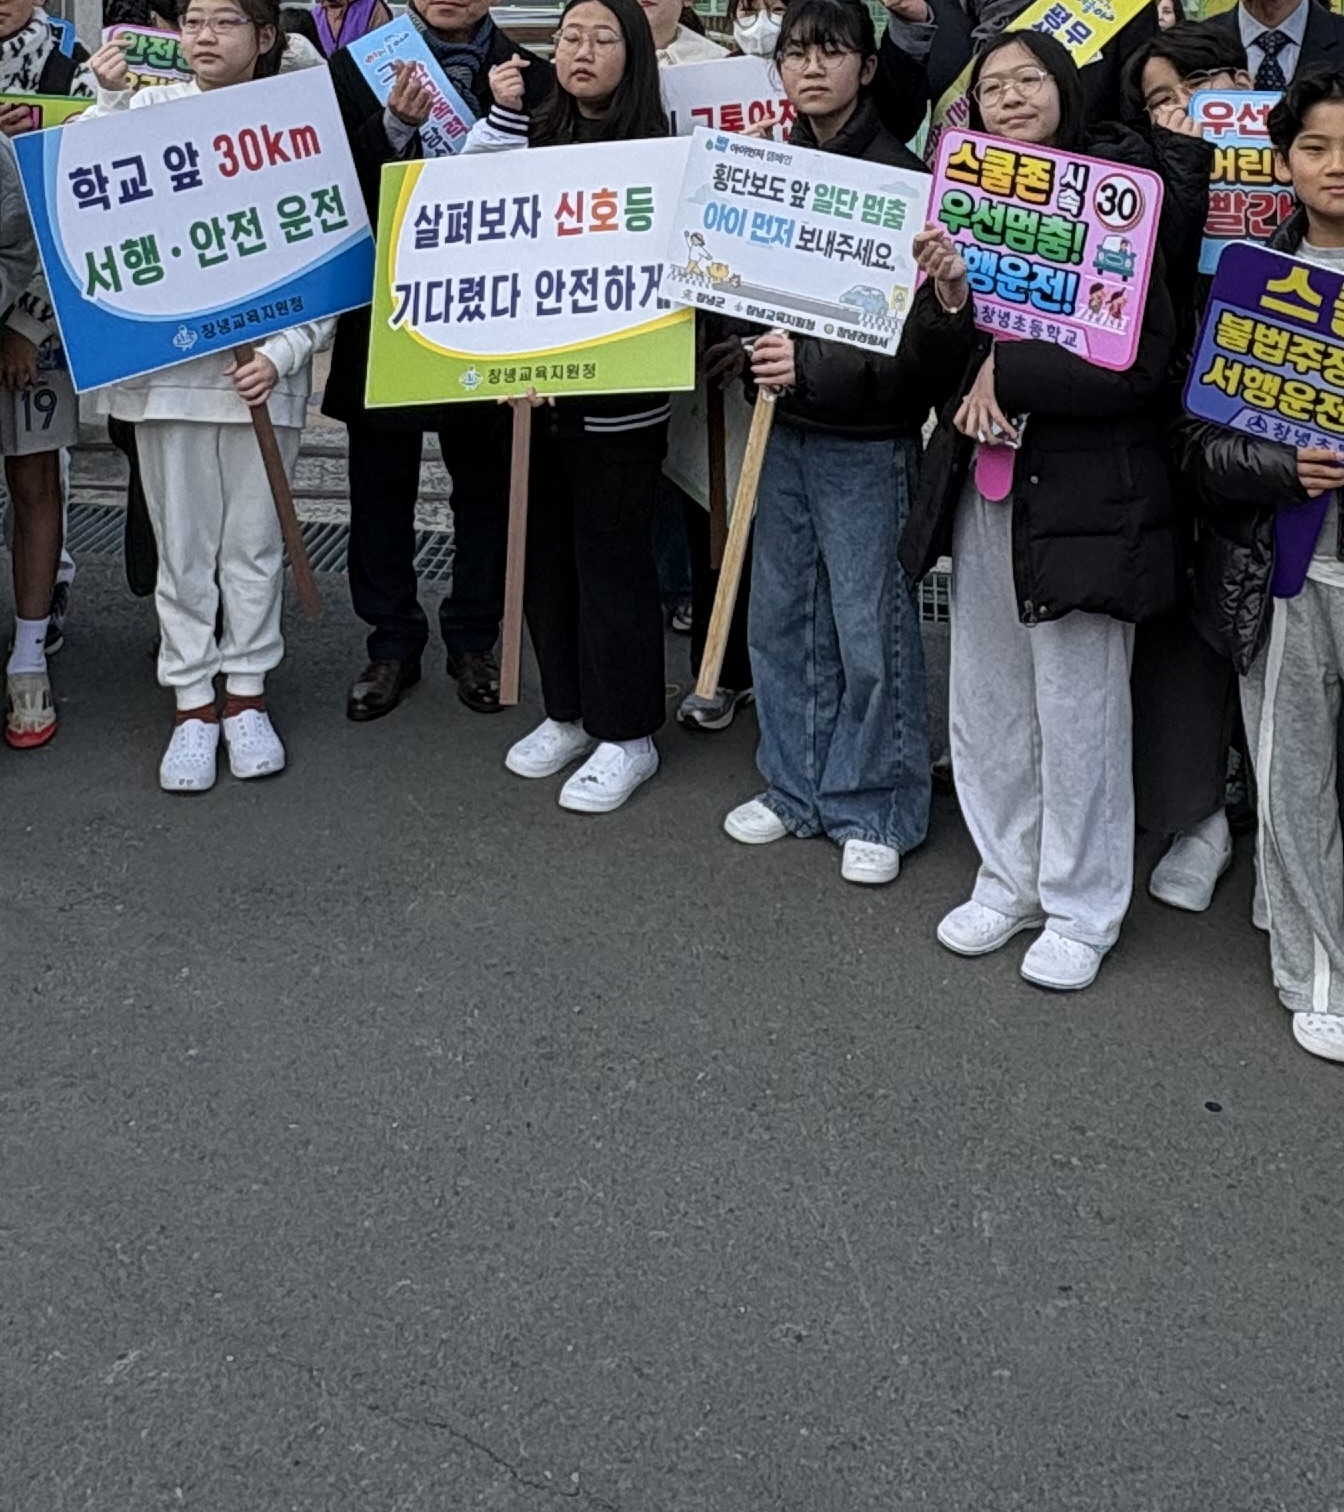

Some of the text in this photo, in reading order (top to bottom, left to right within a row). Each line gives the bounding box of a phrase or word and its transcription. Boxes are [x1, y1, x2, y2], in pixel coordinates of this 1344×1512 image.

[68, 123, 322, 212] 학교 앞 30km
[712, 162, 908, 232] 횡단보도 앞 일단 멈춤
[945, 139, 1138, 221] 스쿨존 시속 30
[275, 184, 350, 244] 운전
[413, 186, 655, 250] 살펴보자 신호등
[703, 201, 896, 272] 아이 먼저 보내주세요.
[939, 188, 1089, 266] 우선멈춤!
[392, 262, 673, 326] 기다렸다 안전하게
[954, 241, 1081, 317] 행운전!
[200, 295, 305, 340] 창녕교육지원청
[980, 304, 1078, 349] 창녕초등학교
[487, 362, 597, 386] 창녕교육지원청
[21, 388, 58, 432] 19
